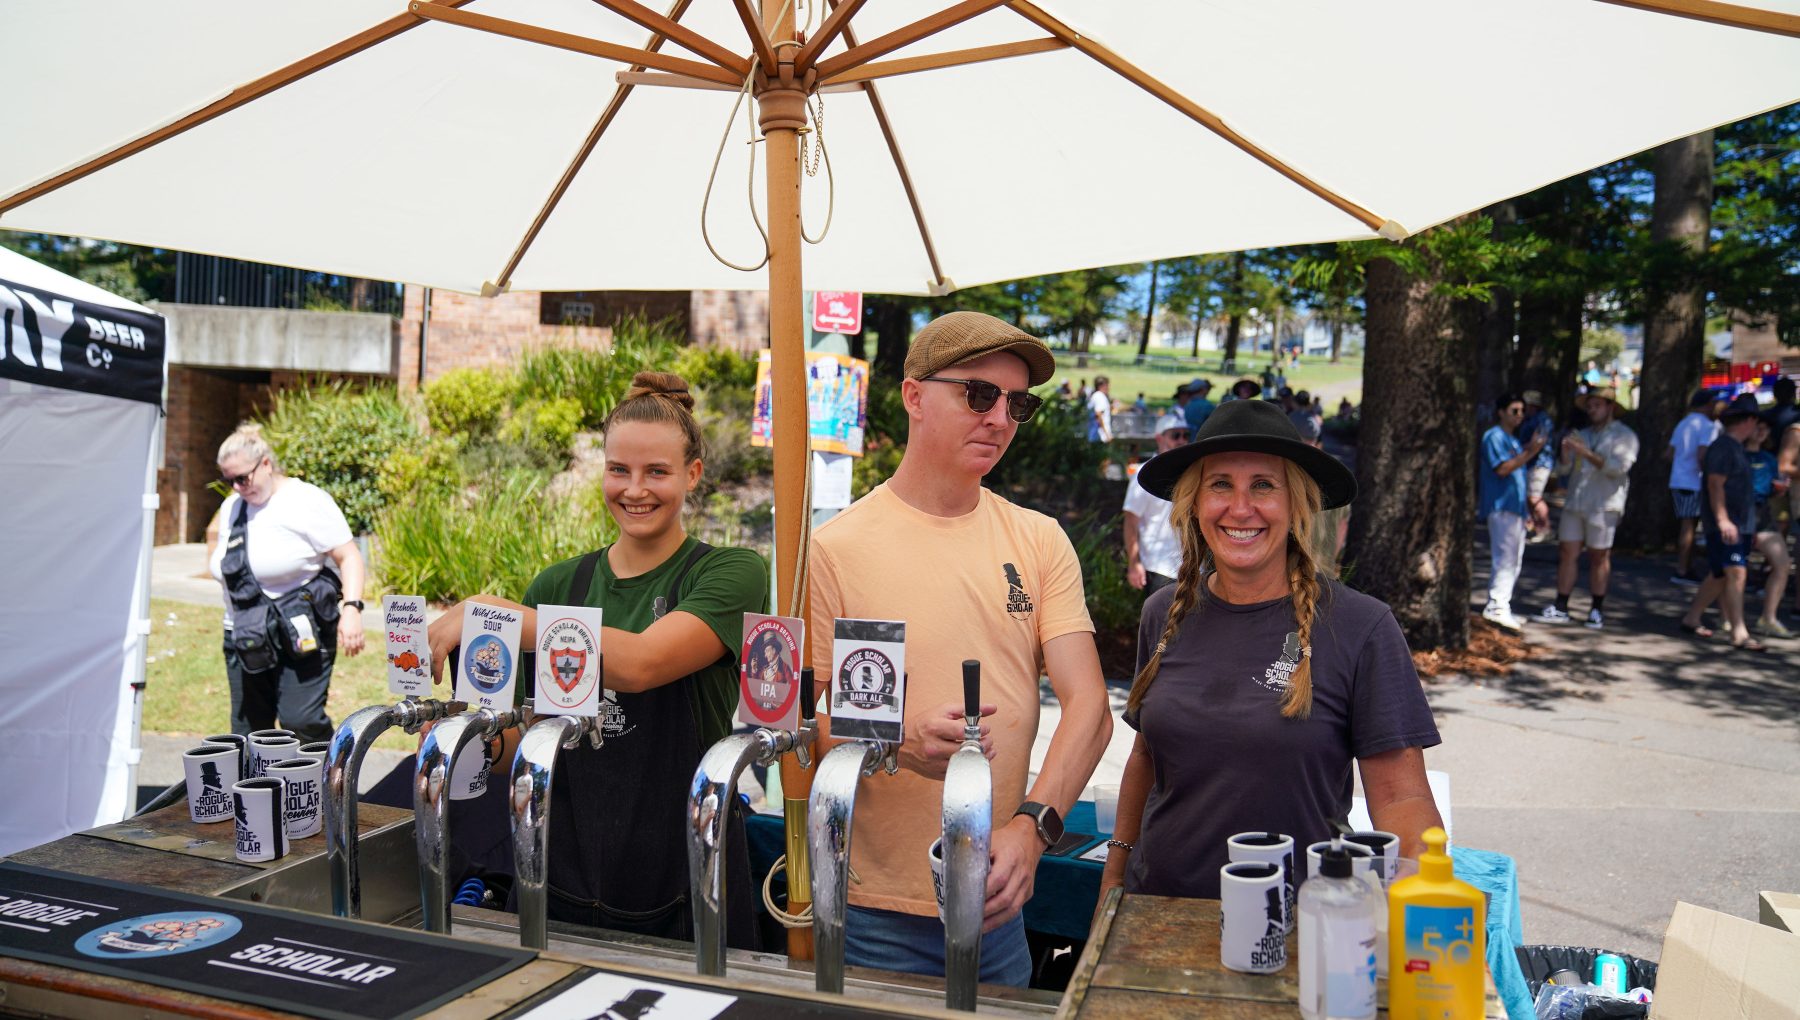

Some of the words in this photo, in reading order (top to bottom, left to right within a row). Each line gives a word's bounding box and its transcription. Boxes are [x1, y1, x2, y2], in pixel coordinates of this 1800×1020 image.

[84, 316, 146, 351] BEER
[388, 601, 418, 613] Alcoholic
[471, 606, 490, 618] Wild
[489, 611, 517, 623] Scholar
[1006, 603, 1033, 613] SCHOAR
[386, 613, 408, 628] Ginger
[483, 620, 502, 633] SOUR
[551, 622, 579, 635] SCHOLAR
[577, 628, 595, 655] BREWING
[757, 622, 780, 632] SCHOLAR
[779, 626, 796, 651] BREWING
[844, 652, 864, 672] ROGUE
[864, 651, 892, 674] SCHOLAR
[1265, 669, 1289, 681] SCHOL
[760, 683, 777, 698] IPA
[850, 692, 868, 701] DARK
[869, 693, 884, 703] ALE
[608, 706, 621, 714] GUE
[606, 715, 625, 725] OLAR
[194, 800, 233, 816] SCHOLAR
[230, 943, 397, 984] SCHOLAR
[1251, 948, 1286, 965] SCHOL
